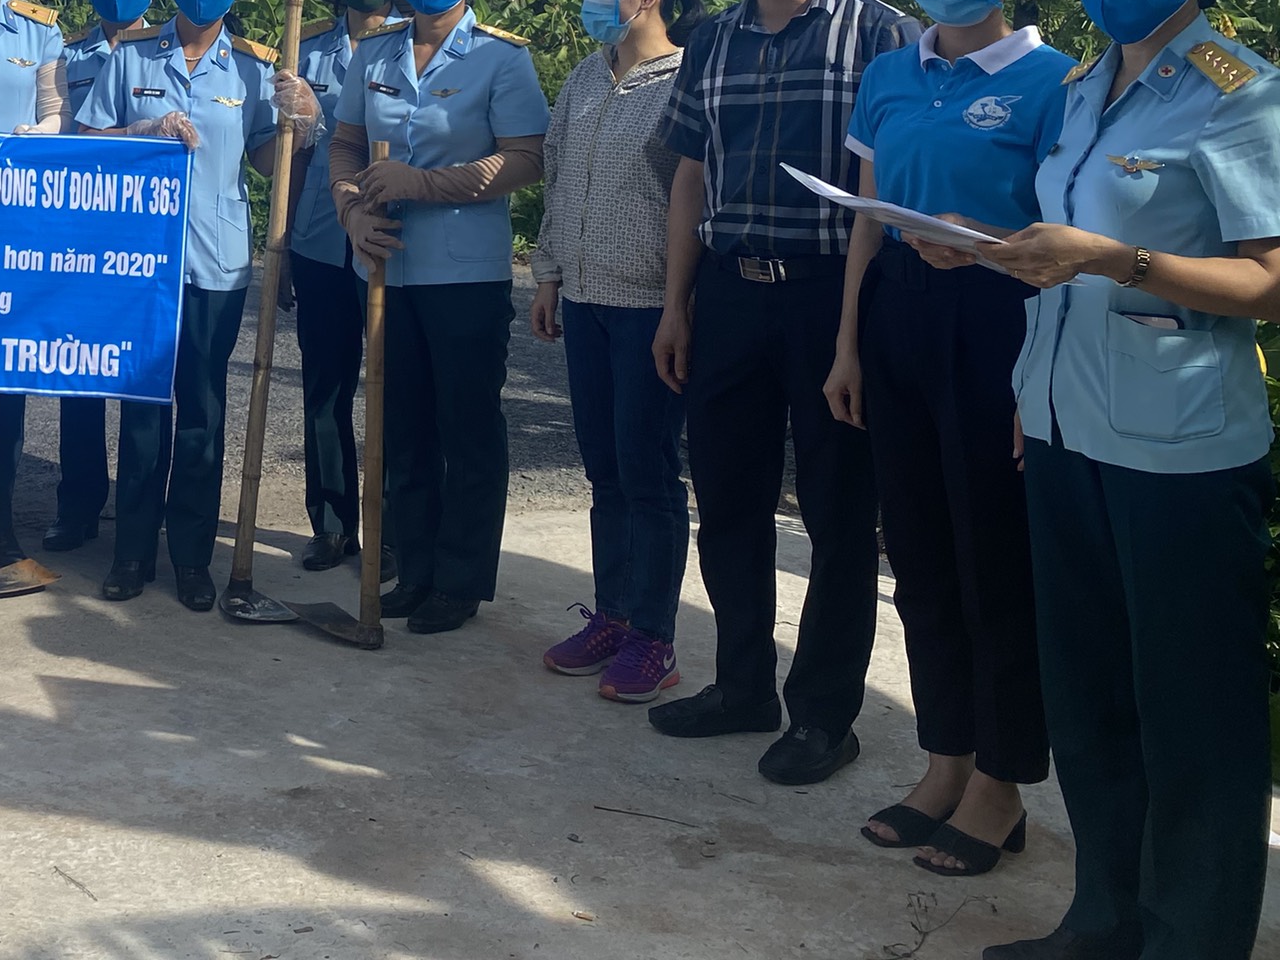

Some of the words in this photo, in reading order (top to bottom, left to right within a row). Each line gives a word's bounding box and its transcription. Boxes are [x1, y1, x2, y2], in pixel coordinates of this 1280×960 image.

[41, 167, 67, 209] SƯ
[69, 165, 117, 212] ĐOÀN
[121, 174, 146, 214] PK
[148, 176, 180, 216] 363
[4, 243, 44, 271] hơn
[50, 247, 96, 274] năm
[102, 251, 168, 278] 2020"
[2, 332, 132, 377] TRƯỜNG"
